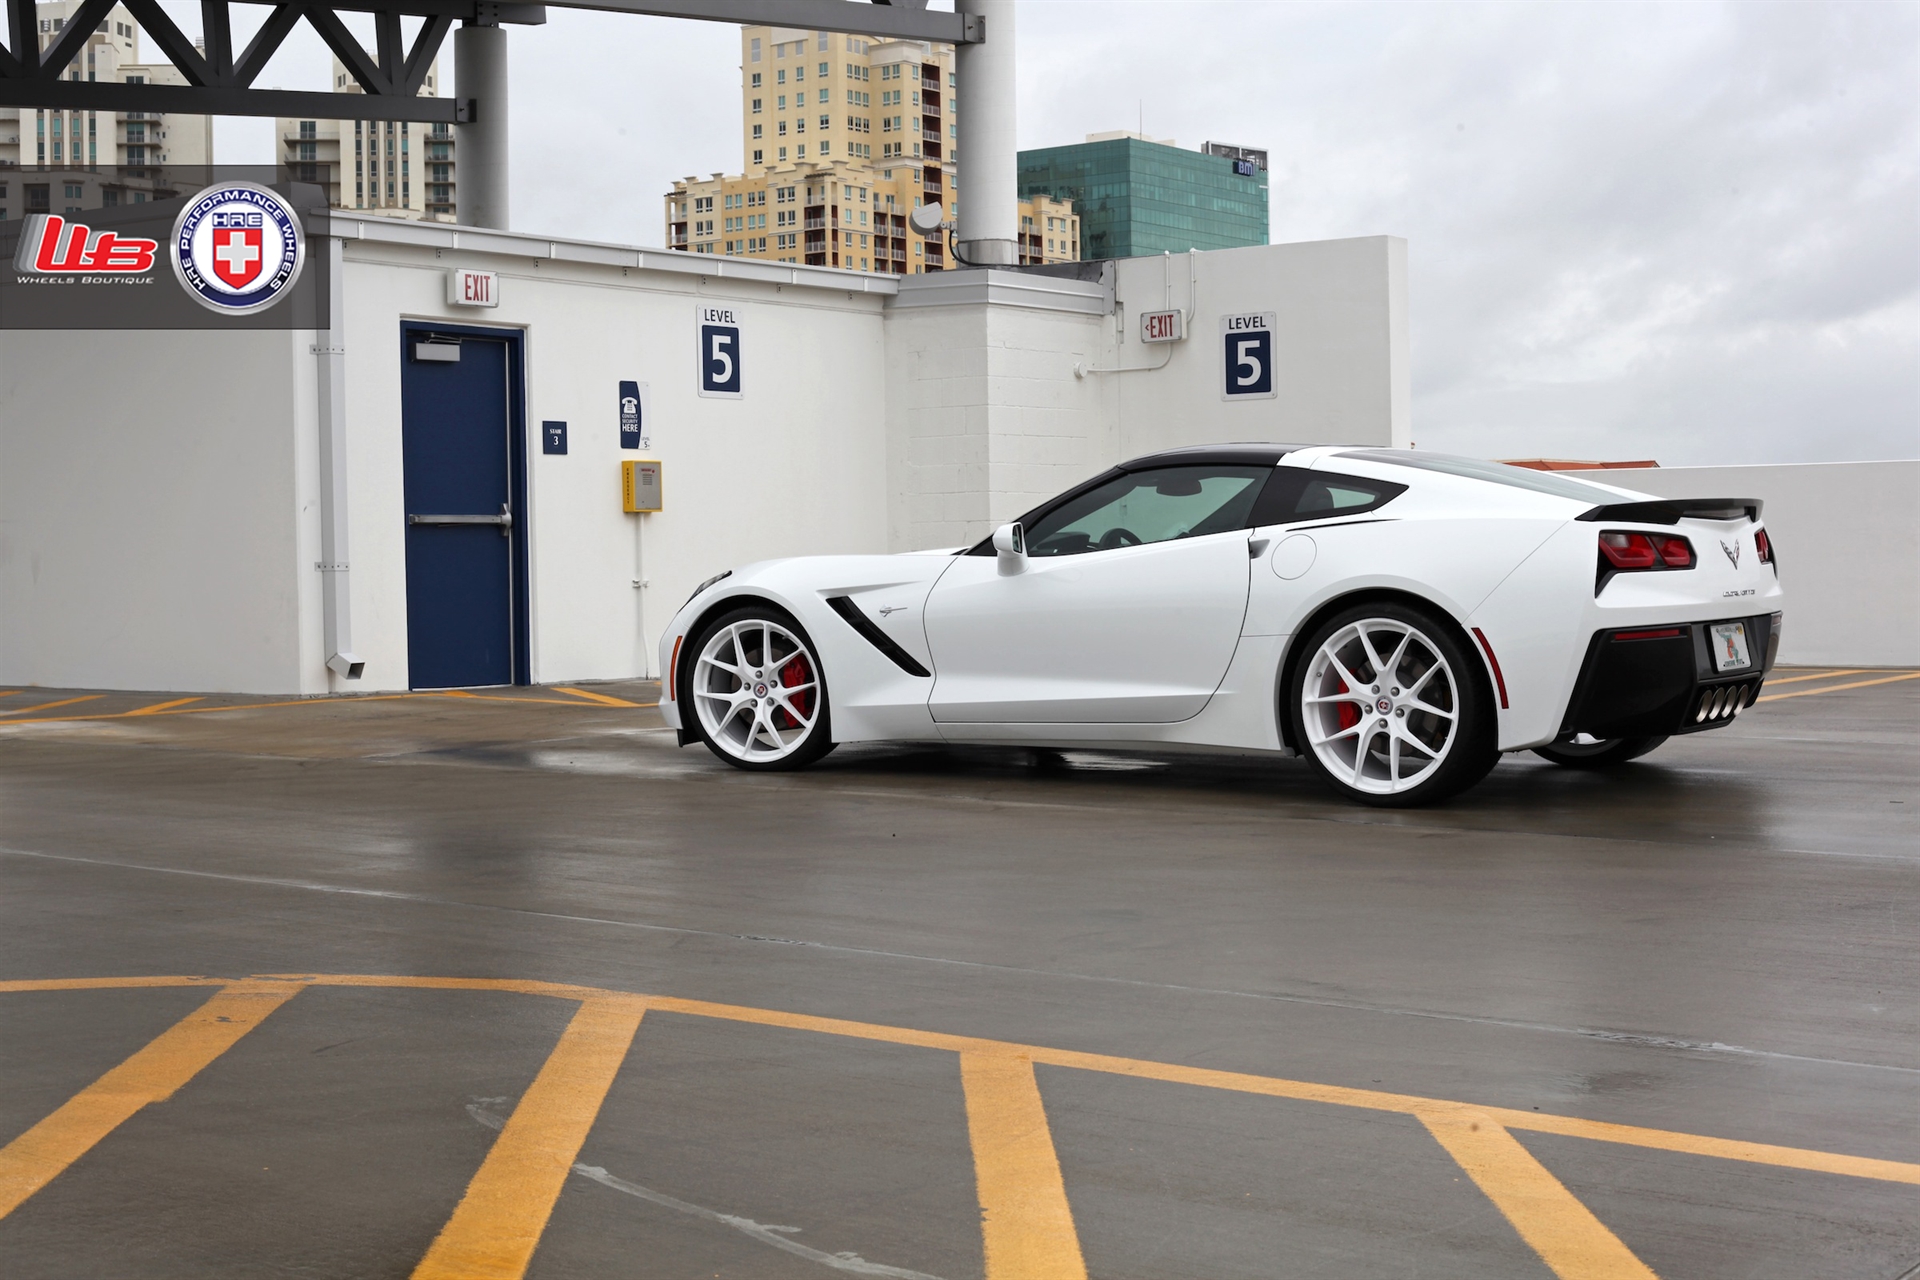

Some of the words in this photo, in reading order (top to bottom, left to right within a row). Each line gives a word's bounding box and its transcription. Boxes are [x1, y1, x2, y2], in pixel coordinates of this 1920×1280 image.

[465, 274, 490, 302] EXIT
[704, 308, 736, 324] LEVEL
[1150, 314, 1174, 338] EXIT
[1228, 316, 1266, 330] LEVEL
[712, 335, 733, 384] 5
[1237, 340, 1262, 386] 5
[622, 423, 638, 432] HERE
[553, 435, 559, 446] 3
